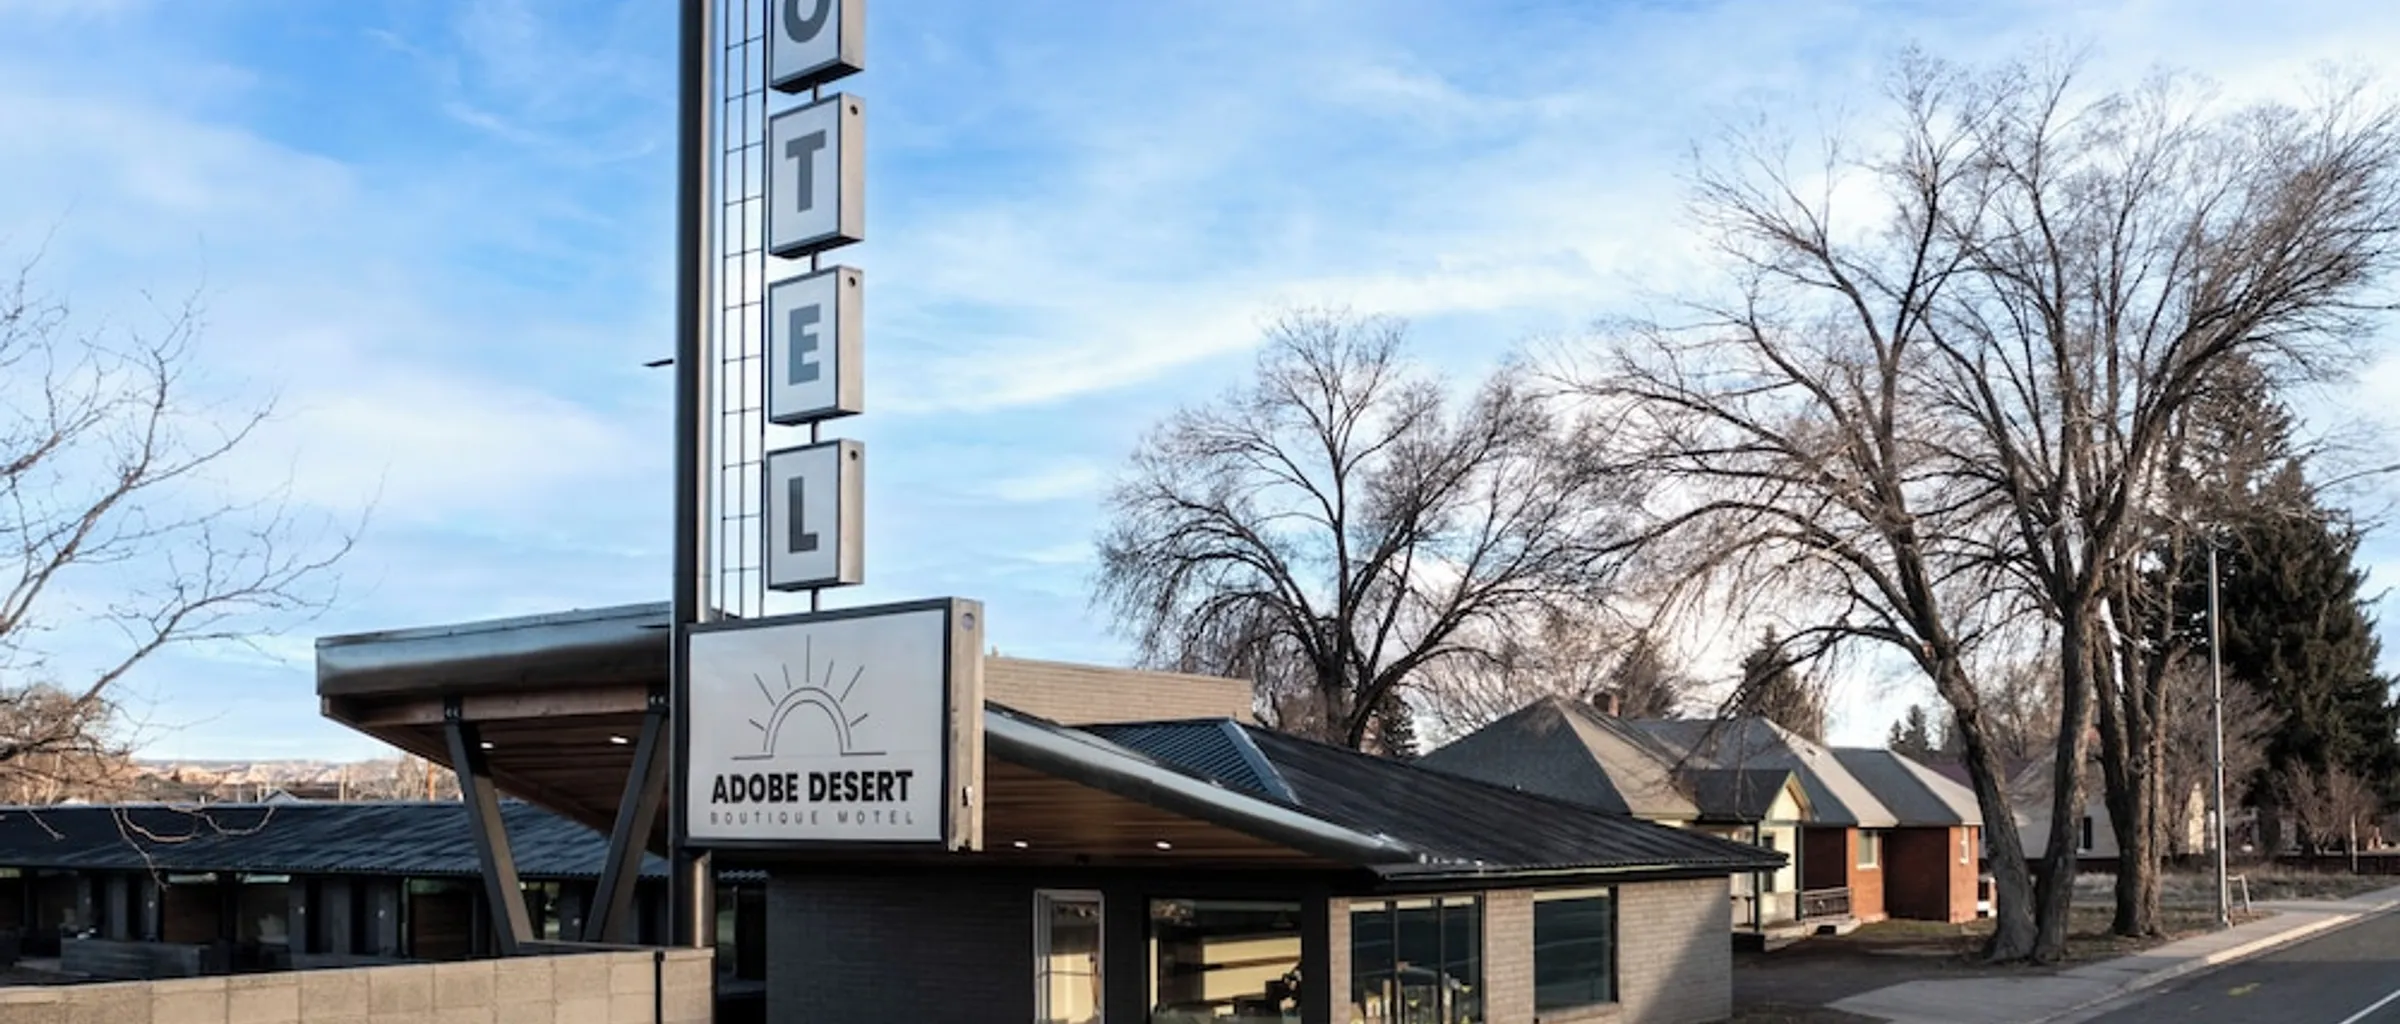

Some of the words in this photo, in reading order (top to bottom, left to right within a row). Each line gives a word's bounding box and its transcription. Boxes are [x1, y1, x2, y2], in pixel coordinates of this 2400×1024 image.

[711, 773, 799, 804] ADOBE
[808, 770, 914, 803] DESERT
[710, 811, 819, 825] BOUTIQUE
[837, 811, 914, 825] MOTEL
